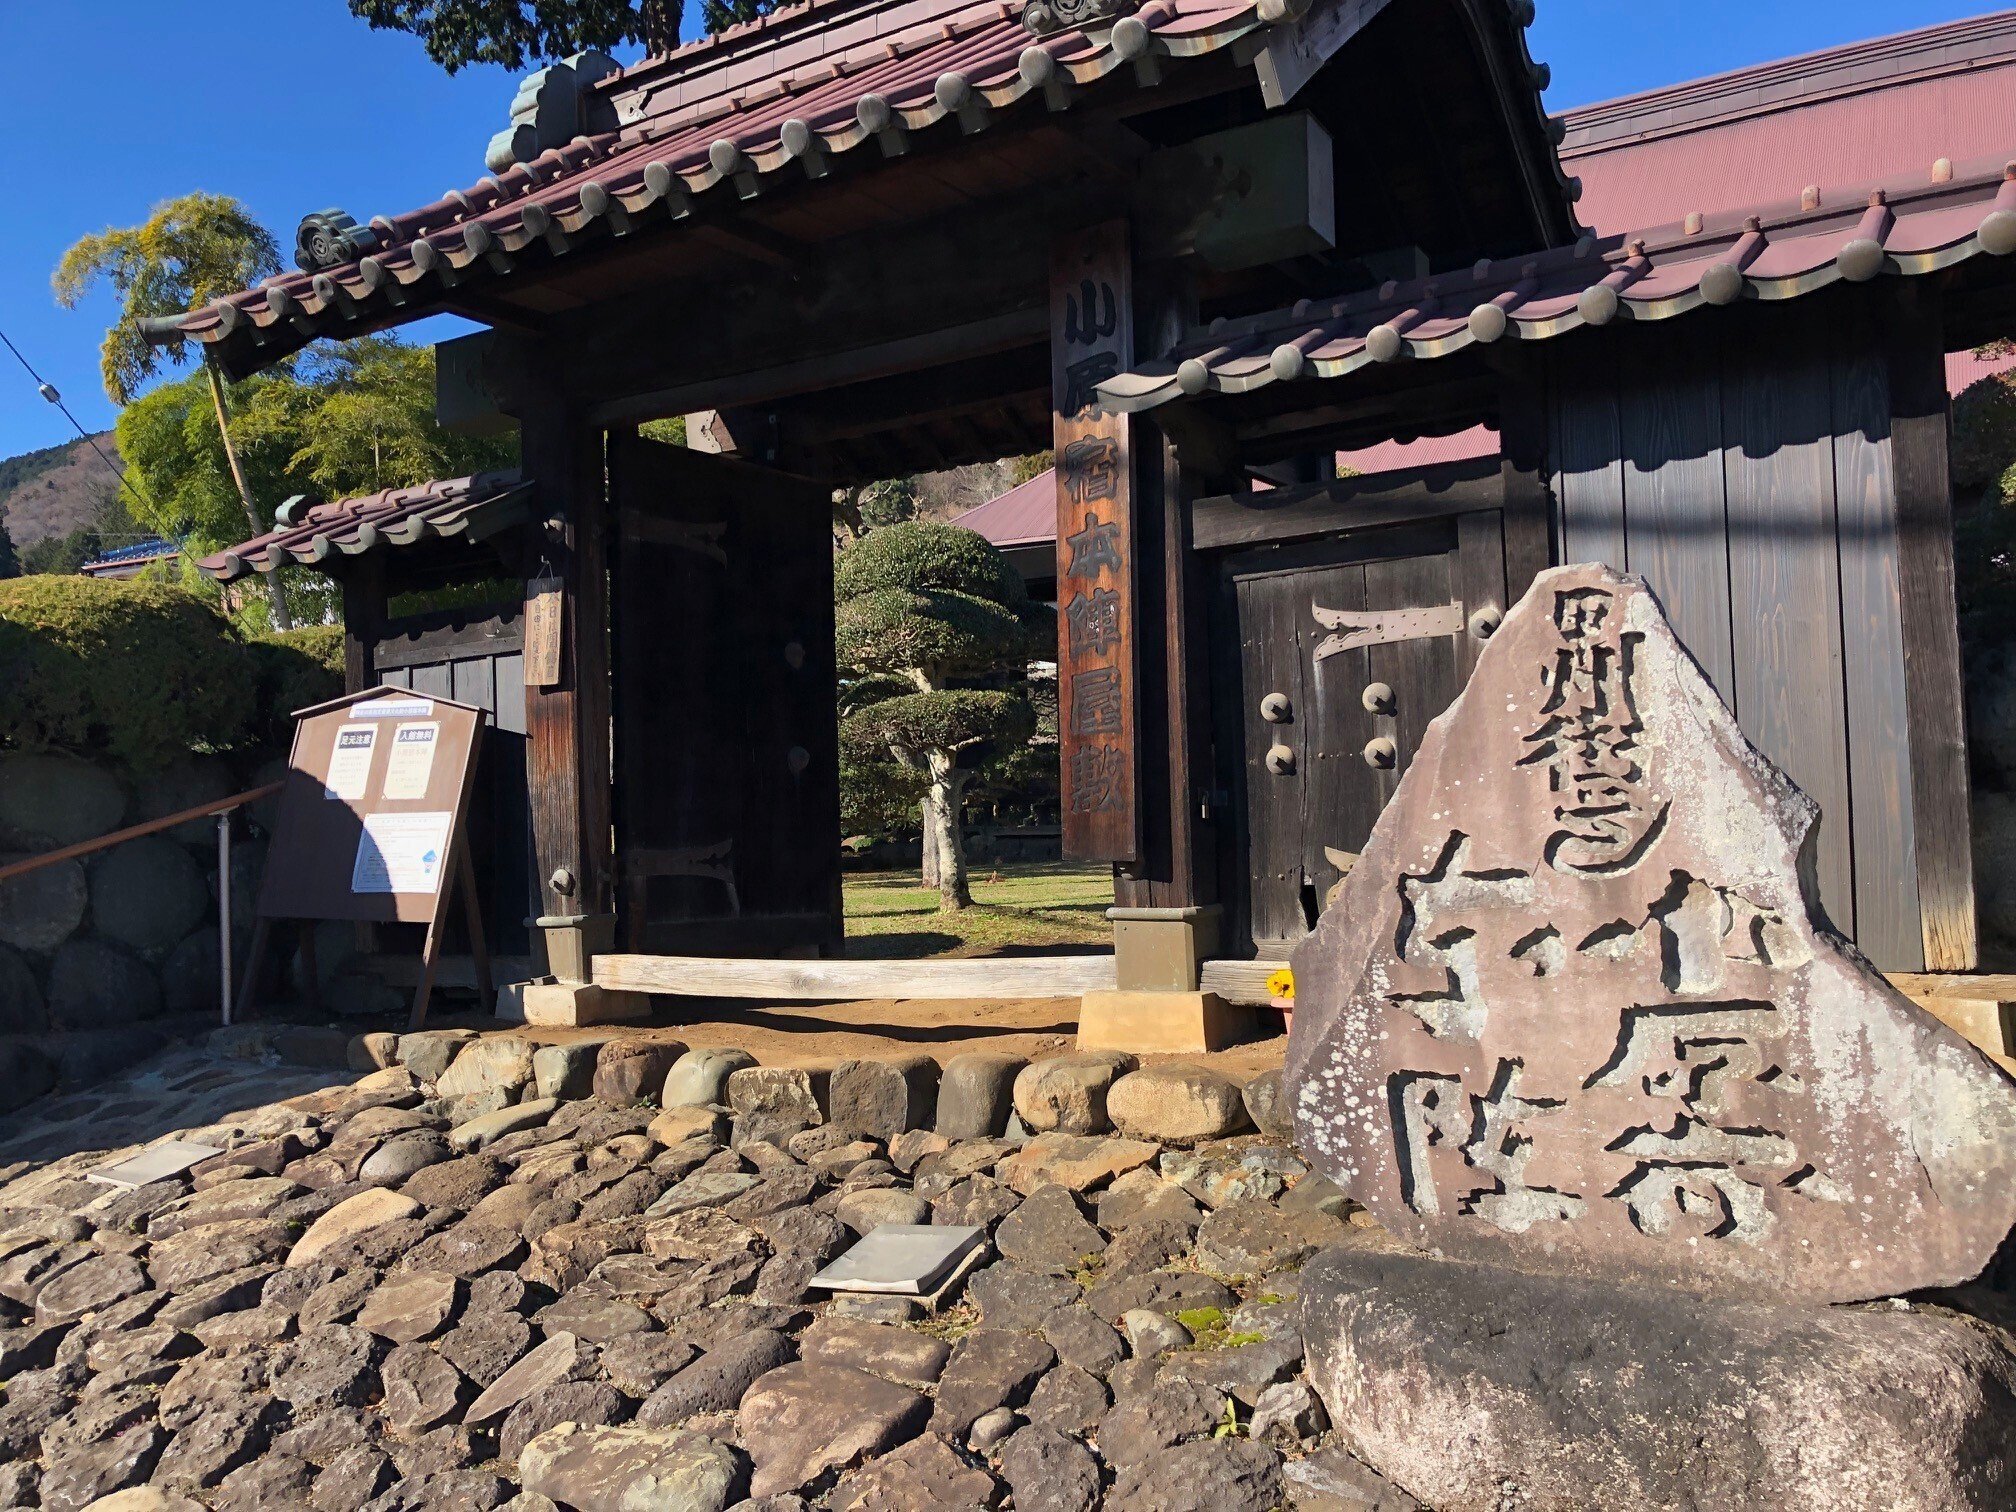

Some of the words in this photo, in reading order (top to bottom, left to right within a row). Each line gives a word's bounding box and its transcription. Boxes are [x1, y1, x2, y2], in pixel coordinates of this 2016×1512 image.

[1063, 278, 1126, 815] 小原宿本陣屋敷
[340, 734, 372, 746] 足元注意
[1516, 586, 1675, 879] 甲州街道
